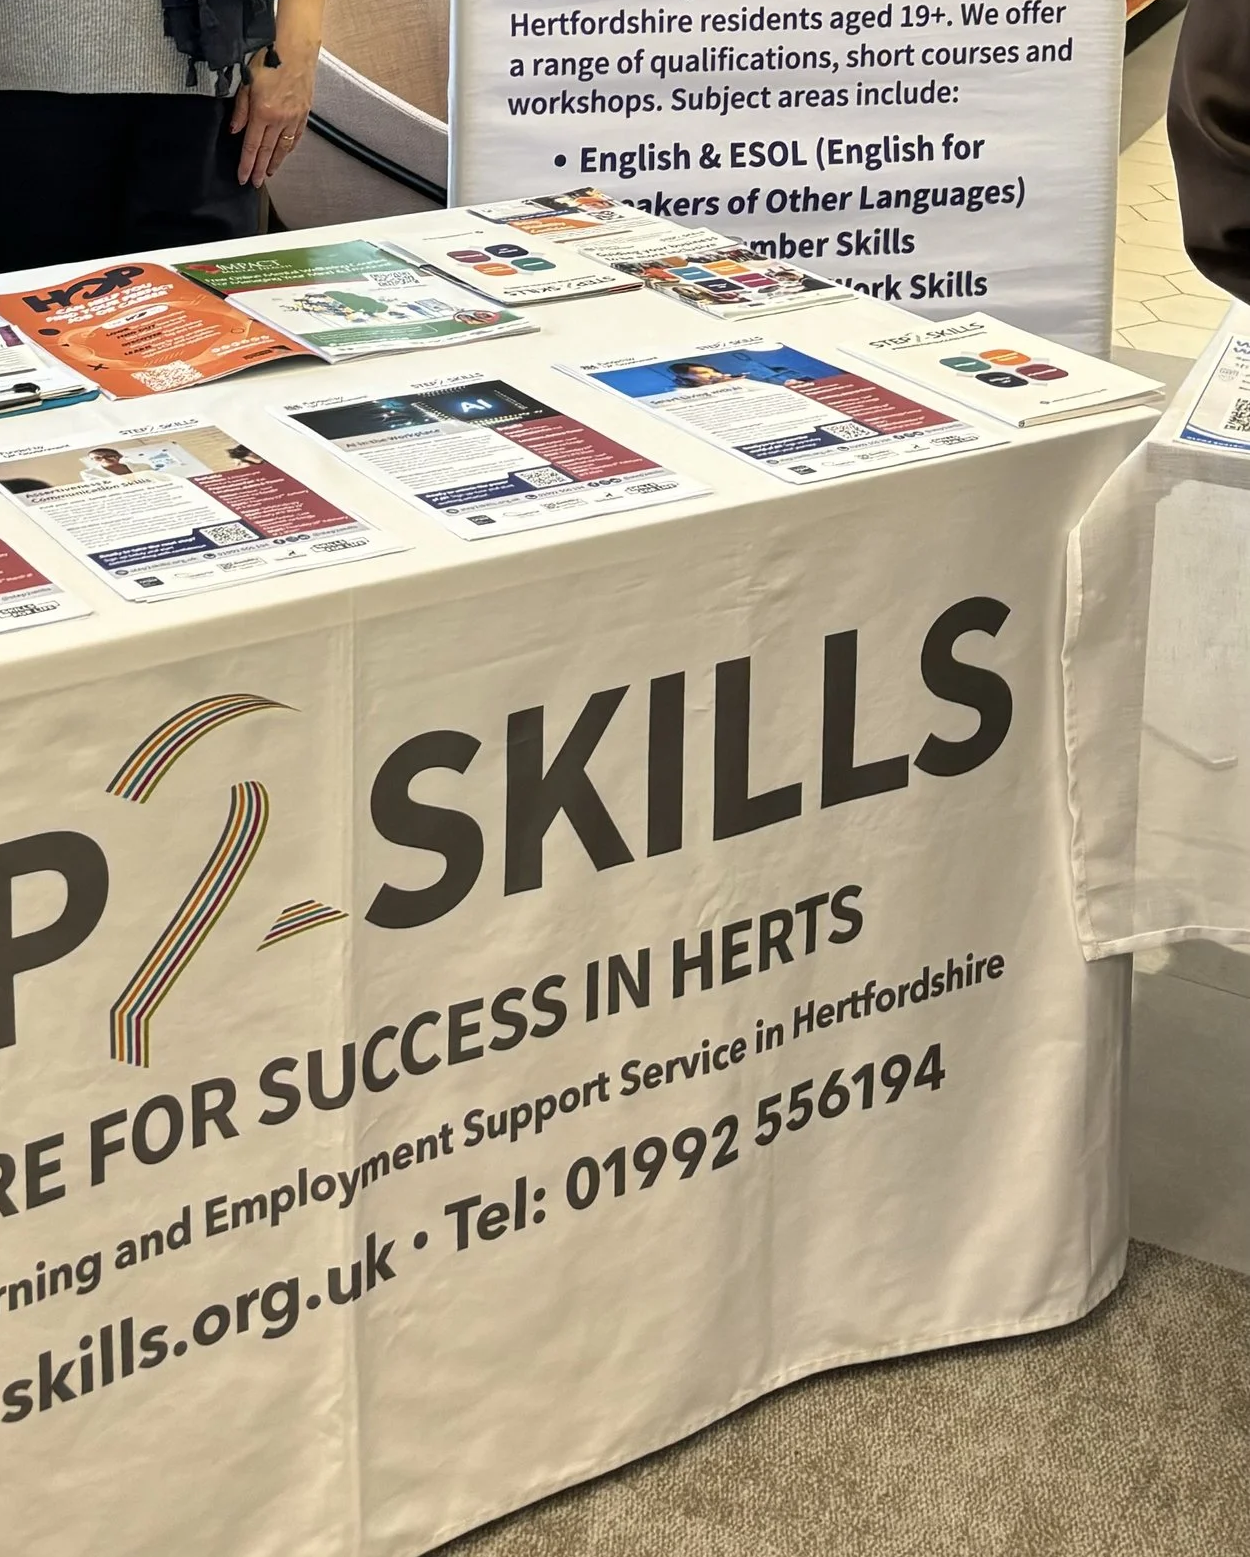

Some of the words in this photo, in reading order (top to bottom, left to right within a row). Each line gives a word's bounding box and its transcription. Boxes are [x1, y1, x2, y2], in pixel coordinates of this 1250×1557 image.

[510, 8, 693, 38] Hertfordshire
[700, 5, 823, 33] residents
[829, 2, 893, 36] aged
[901, 4, 953, 28] 19+.
[961, 2, 999, 27] We
[1005, 0, 1067, 25] offer
[509, 58, 525, 78] a
[532, 56, 610, 83] range
[616, 48, 646, 75] of
[650, 44, 839, 80] qualifications,
[846, 42, 916, 68] short
[921, 45, 1020, 67] courses
[1026, 36, 1073, 63] and
[507, 88, 663, 119] workshops.
[670, 85, 772, 117] Subject
[777, 88, 849, 109] areas
[856, 78, 959, 106] include:
[580, 142, 691, 178] English
[698, 142, 722, 170] &
[730, 140, 808, 169] ESOL
[816, 134, 935, 174] (English
[941, 132, 986, 161] for
[726, 187, 761, 216] of
[765, 185, 853, 214] Other
[859, 175, 1026, 217] Languages)
[743, 232, 830, 262] mber
[835, 227, 916, 257] Skills
[217, 259, 280, 272] IMPACT
[45, 311, 79, 323] FIND
[81, 299, 119, 315] YOUR
[121, 284, 174, 302] PERFECT
[55, 304, 86, 315] CAN
[88, 293, 120, 307] HELP
[123, 282, 153, 294] YOU
[117, 290, 168, 308] CAREER
[909, 269, 988, 301] Skills
[460, 397, 493, 413] AI
[26, 481, 101, 499] Assertiveness
[30, 485, 121, 504] Communication
[89, 1077, 240, 1188] FOR
[257, 974, 568, 1126] SUCCESS
[585, 946, 652, 1023] IN
[672, 884, 864, 1000] HERTS
[114, 1204, 192, 1270] and
[205, 1122, 454, 1239] Employment
[463, 1071, 611, 1148] Support
[619, 1036, 748, 1097] Service
[755, 1017, 784, 1055] in
[792, 950, 1005, 1040] Hertfordshire
[443, 1175, 546, 1253] Tel:
[565, 1114, 739, 1211] 01992
[753, 1042, 946, 1147] 556194
